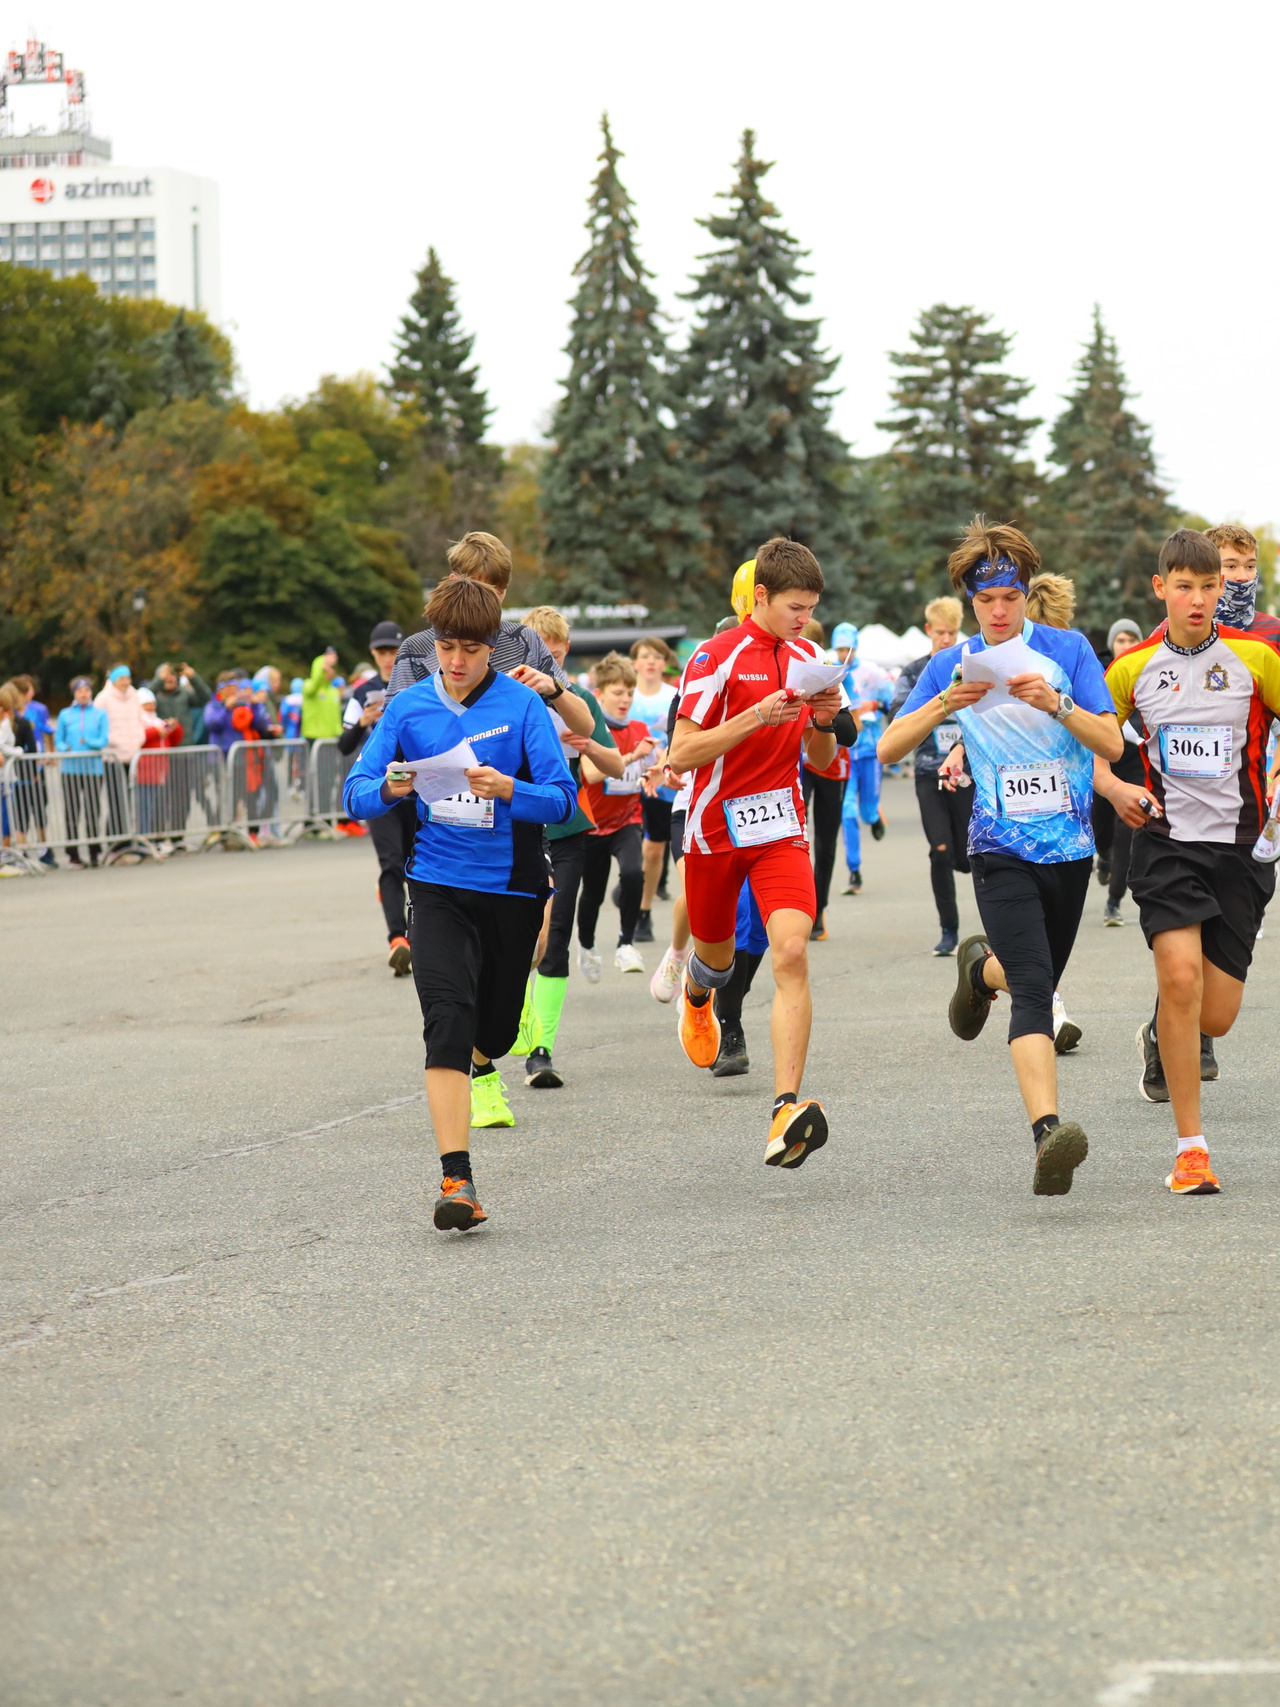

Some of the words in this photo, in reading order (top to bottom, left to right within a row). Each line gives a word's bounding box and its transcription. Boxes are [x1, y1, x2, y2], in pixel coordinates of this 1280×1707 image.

[65, 176, 152, 199] azimut
[738, 673, 769, 681] RUSSIA
[466, 725, 509, 744] noname
[1169, 739, 1220, 757] 306.1
[1005, 775, 1058, 798] 305.1
[736, 802, 784, 827] 322.1
